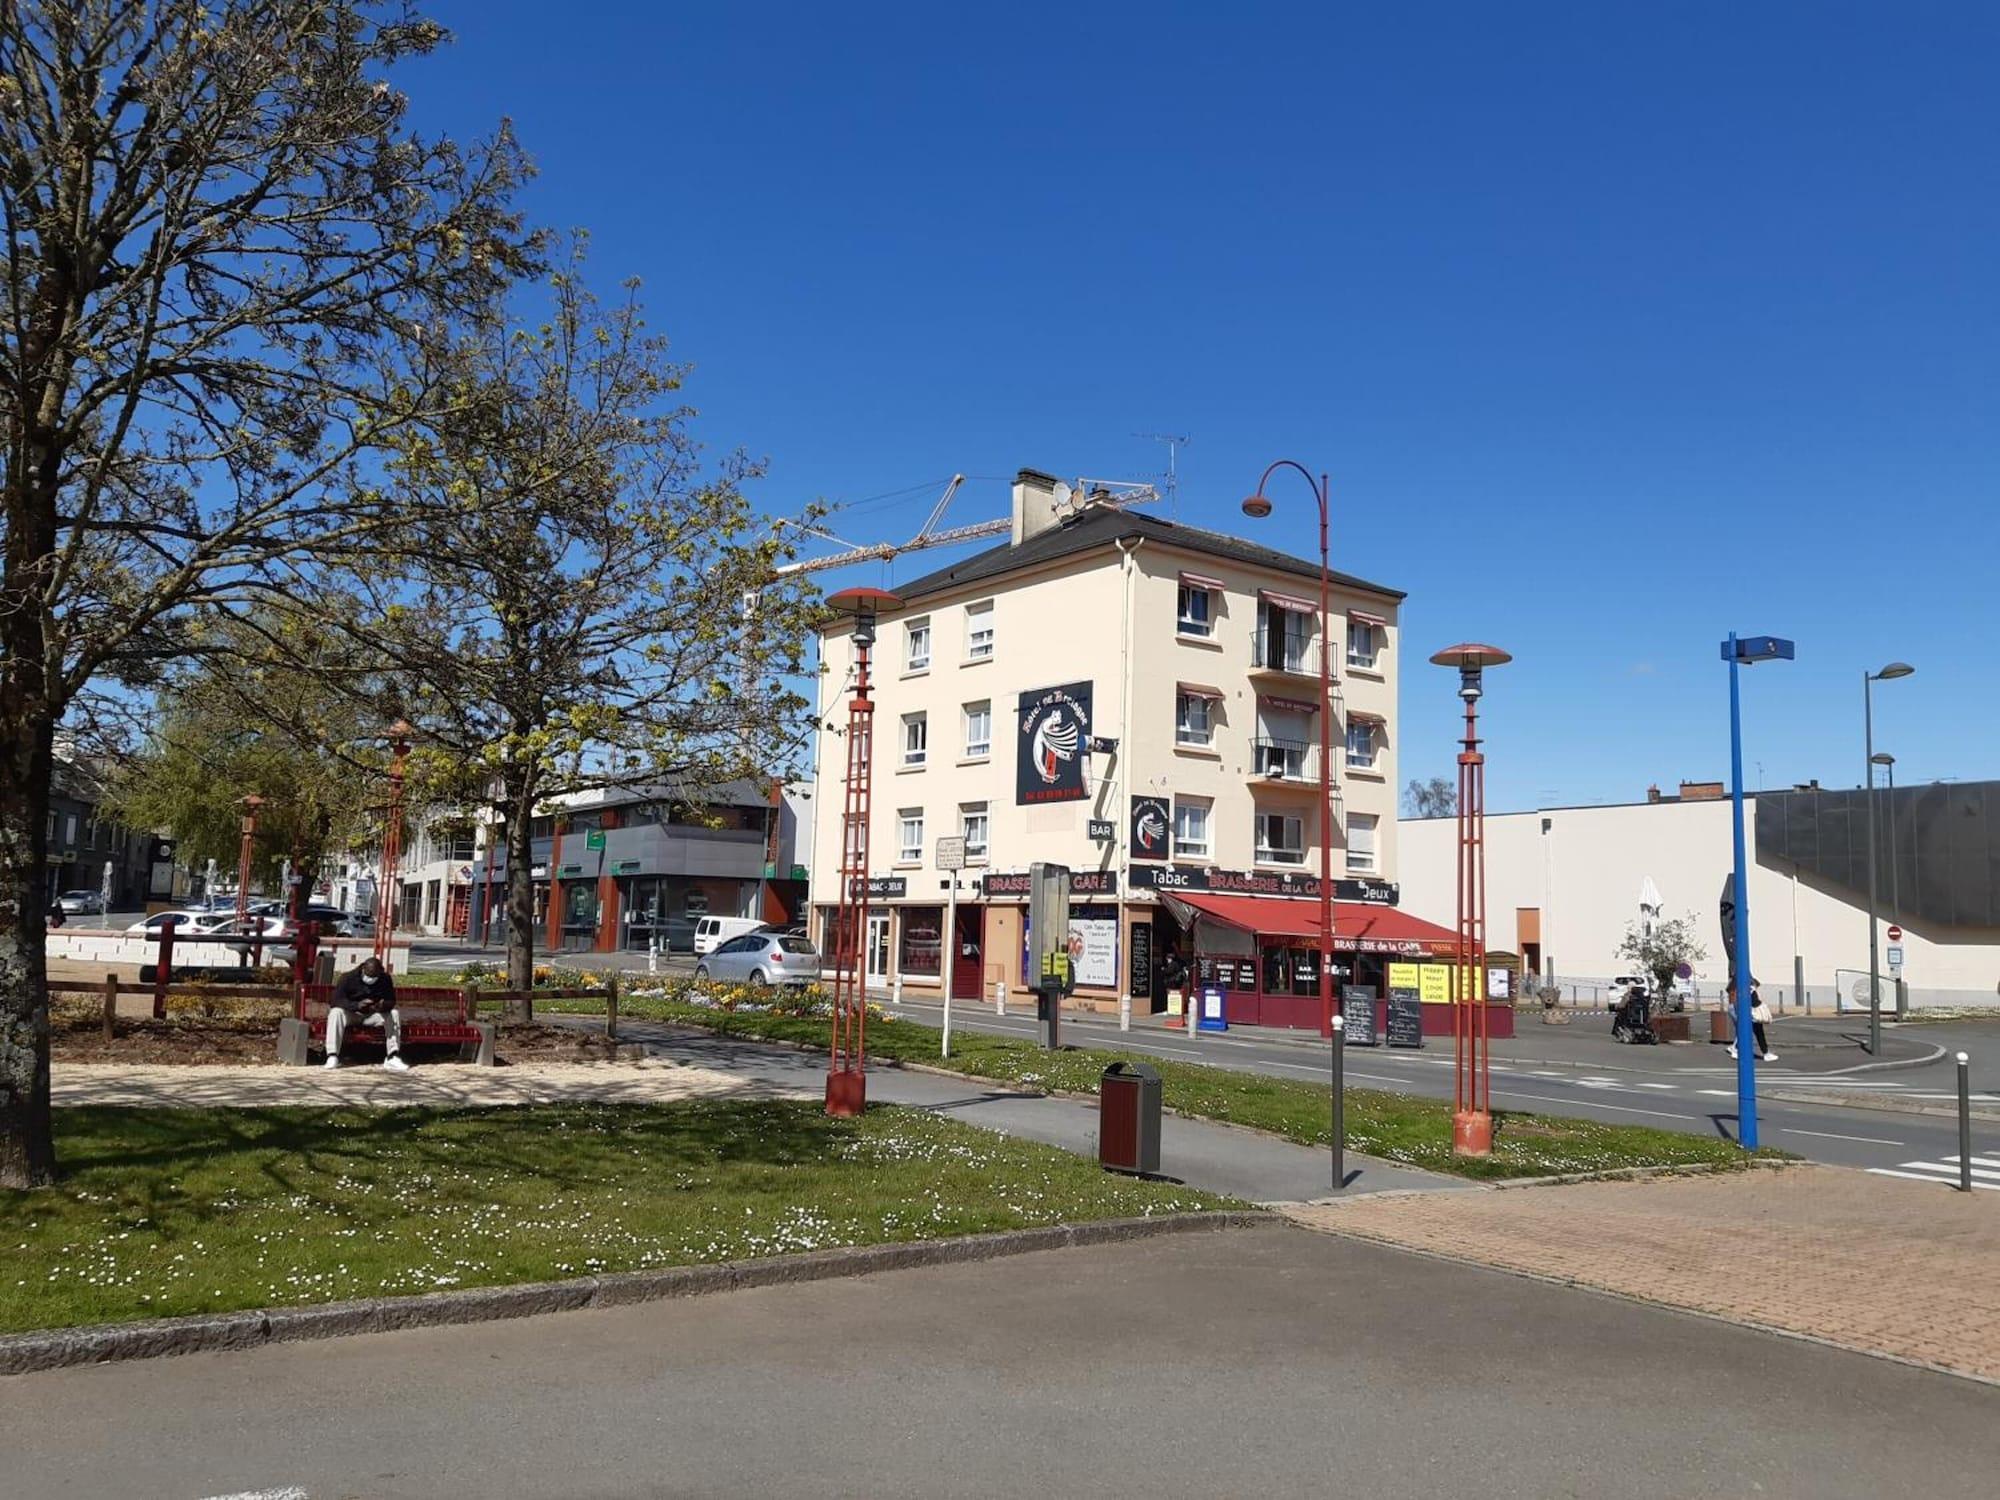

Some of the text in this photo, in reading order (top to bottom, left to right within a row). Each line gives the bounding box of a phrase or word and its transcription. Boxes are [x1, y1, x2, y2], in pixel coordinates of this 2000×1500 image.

[1091, 825, 1111, 836] BAR
[989, 877, 1031, 890] BRASSE
[1151, 870, 1189, 885] Tabac
[1209, 874, 1278, 891] BRASSERIE
[1293, 886, 1302, 894] LA
[1305, 881, 1337, 896] GAE
[1363, 885, 1389, 899] Jeux
[1377, 942, 1388, 951] de
[1388, 943, 1397, 951] la
